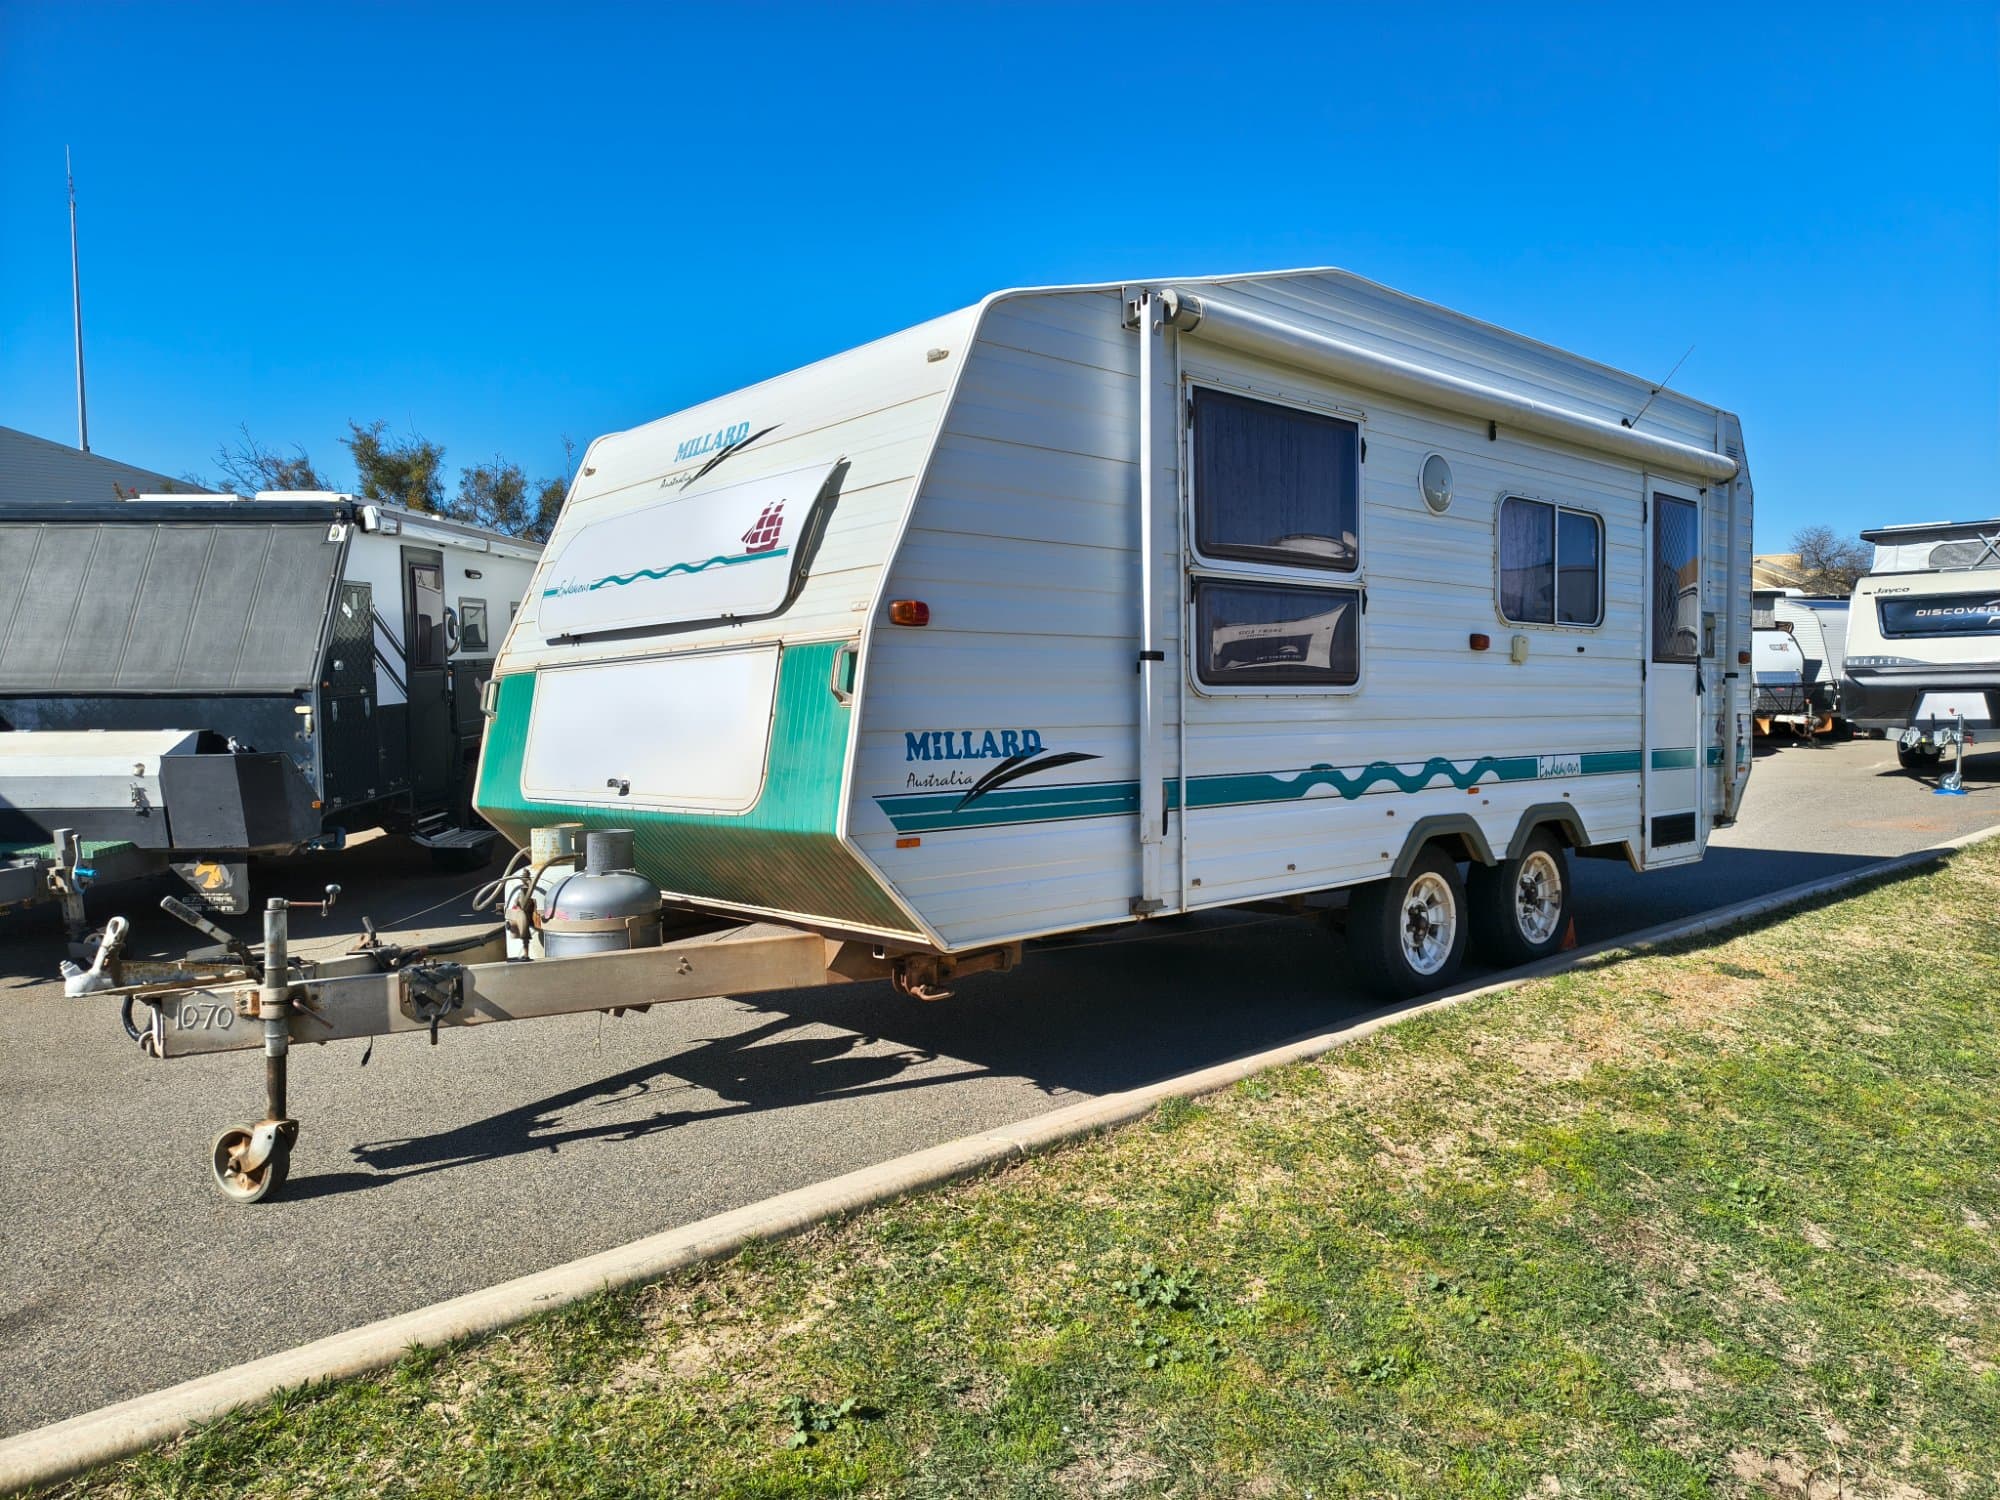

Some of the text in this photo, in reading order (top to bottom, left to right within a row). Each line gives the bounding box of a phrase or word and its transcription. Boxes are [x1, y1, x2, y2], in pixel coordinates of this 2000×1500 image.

[673, 421, 750, 463] MILLARD
[1873, 587, 1910, 595] Jayco
[905, 729, 1042, 762] MILLARD
[906, 770, 974, 789] Australia
[175, 1001, 235, 1031] 1070
